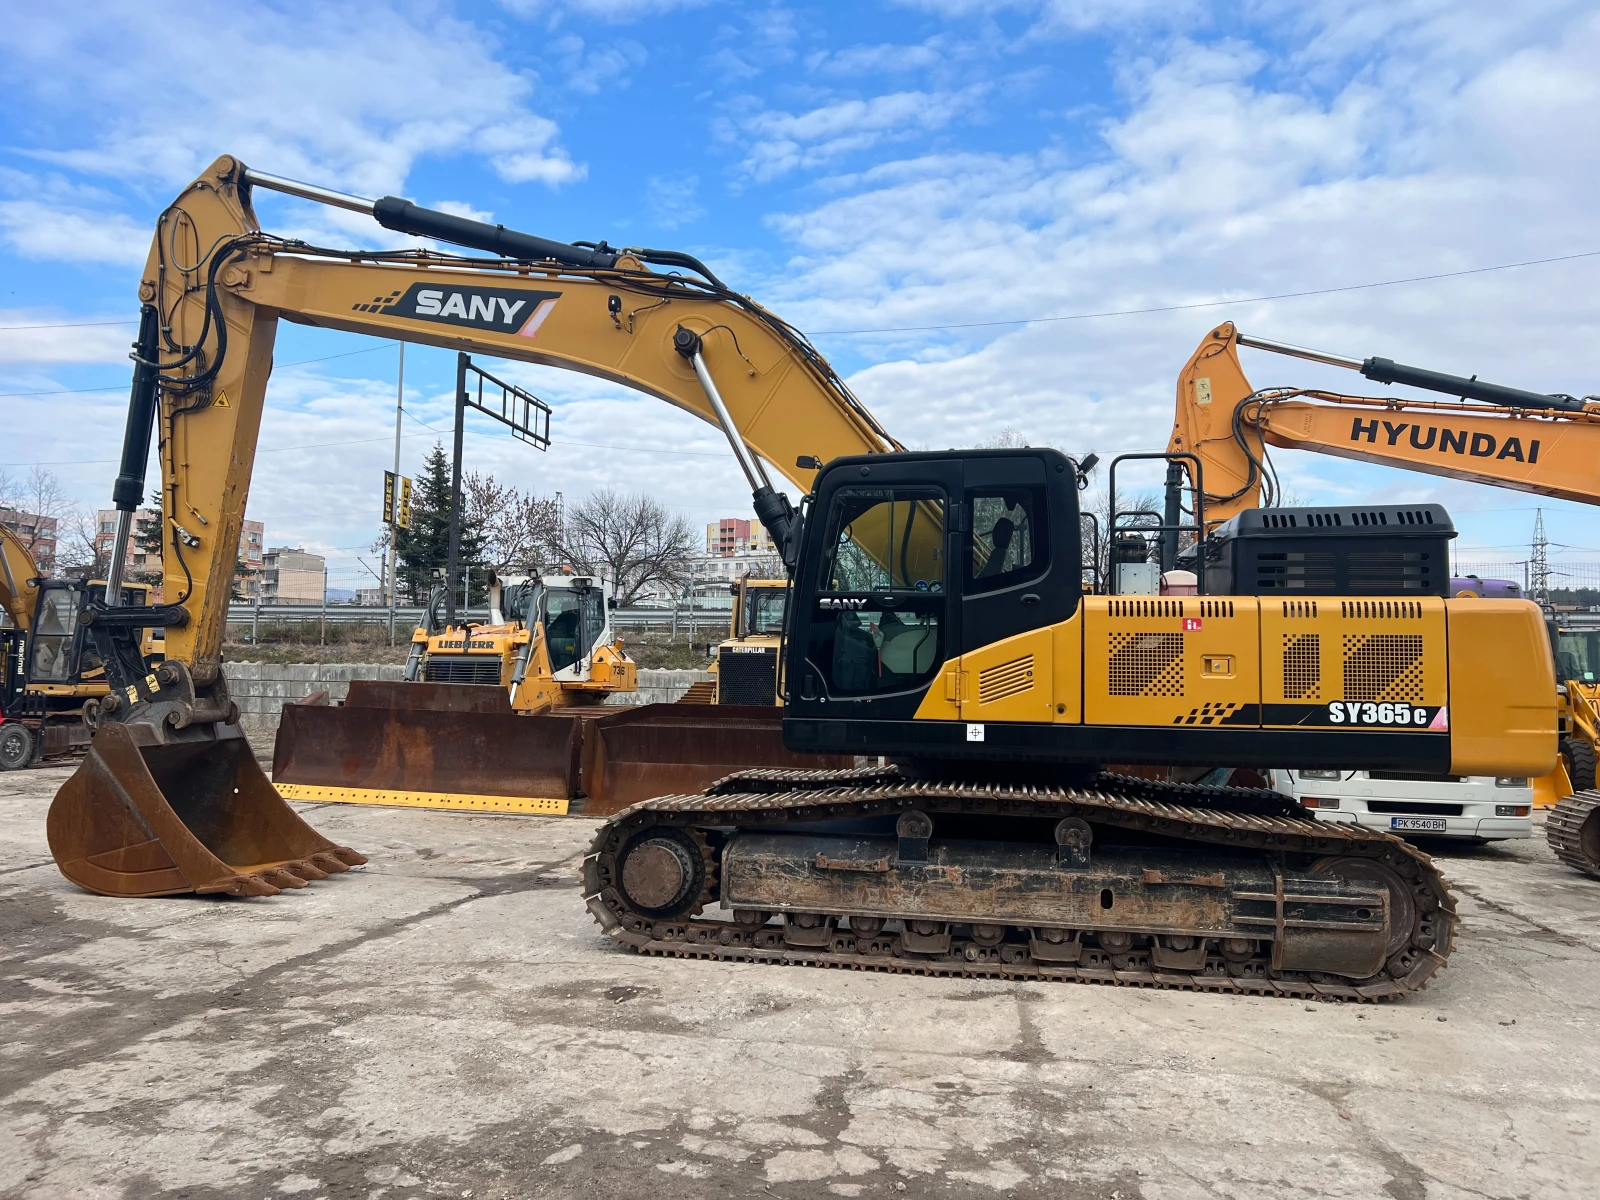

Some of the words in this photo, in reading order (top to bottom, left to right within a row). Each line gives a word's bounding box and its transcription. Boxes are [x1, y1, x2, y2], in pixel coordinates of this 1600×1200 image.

[415, 289, 527, 324] SANY
[1350, 417, 1541, 464] HYUNDAI
[819, 598, 867, 610] SANY
[438, 640, 495, 649] LIEBERR
[732, 646, 766, 654] CATERPILLAR
[17, 640, 25, 675] maximal
[612, 665, 626, 675] 736
[1397, 819, 1409, 828] PK
[1410, 820, 1431, 829] 9540
[1432, 820, 1444, 830] BH
